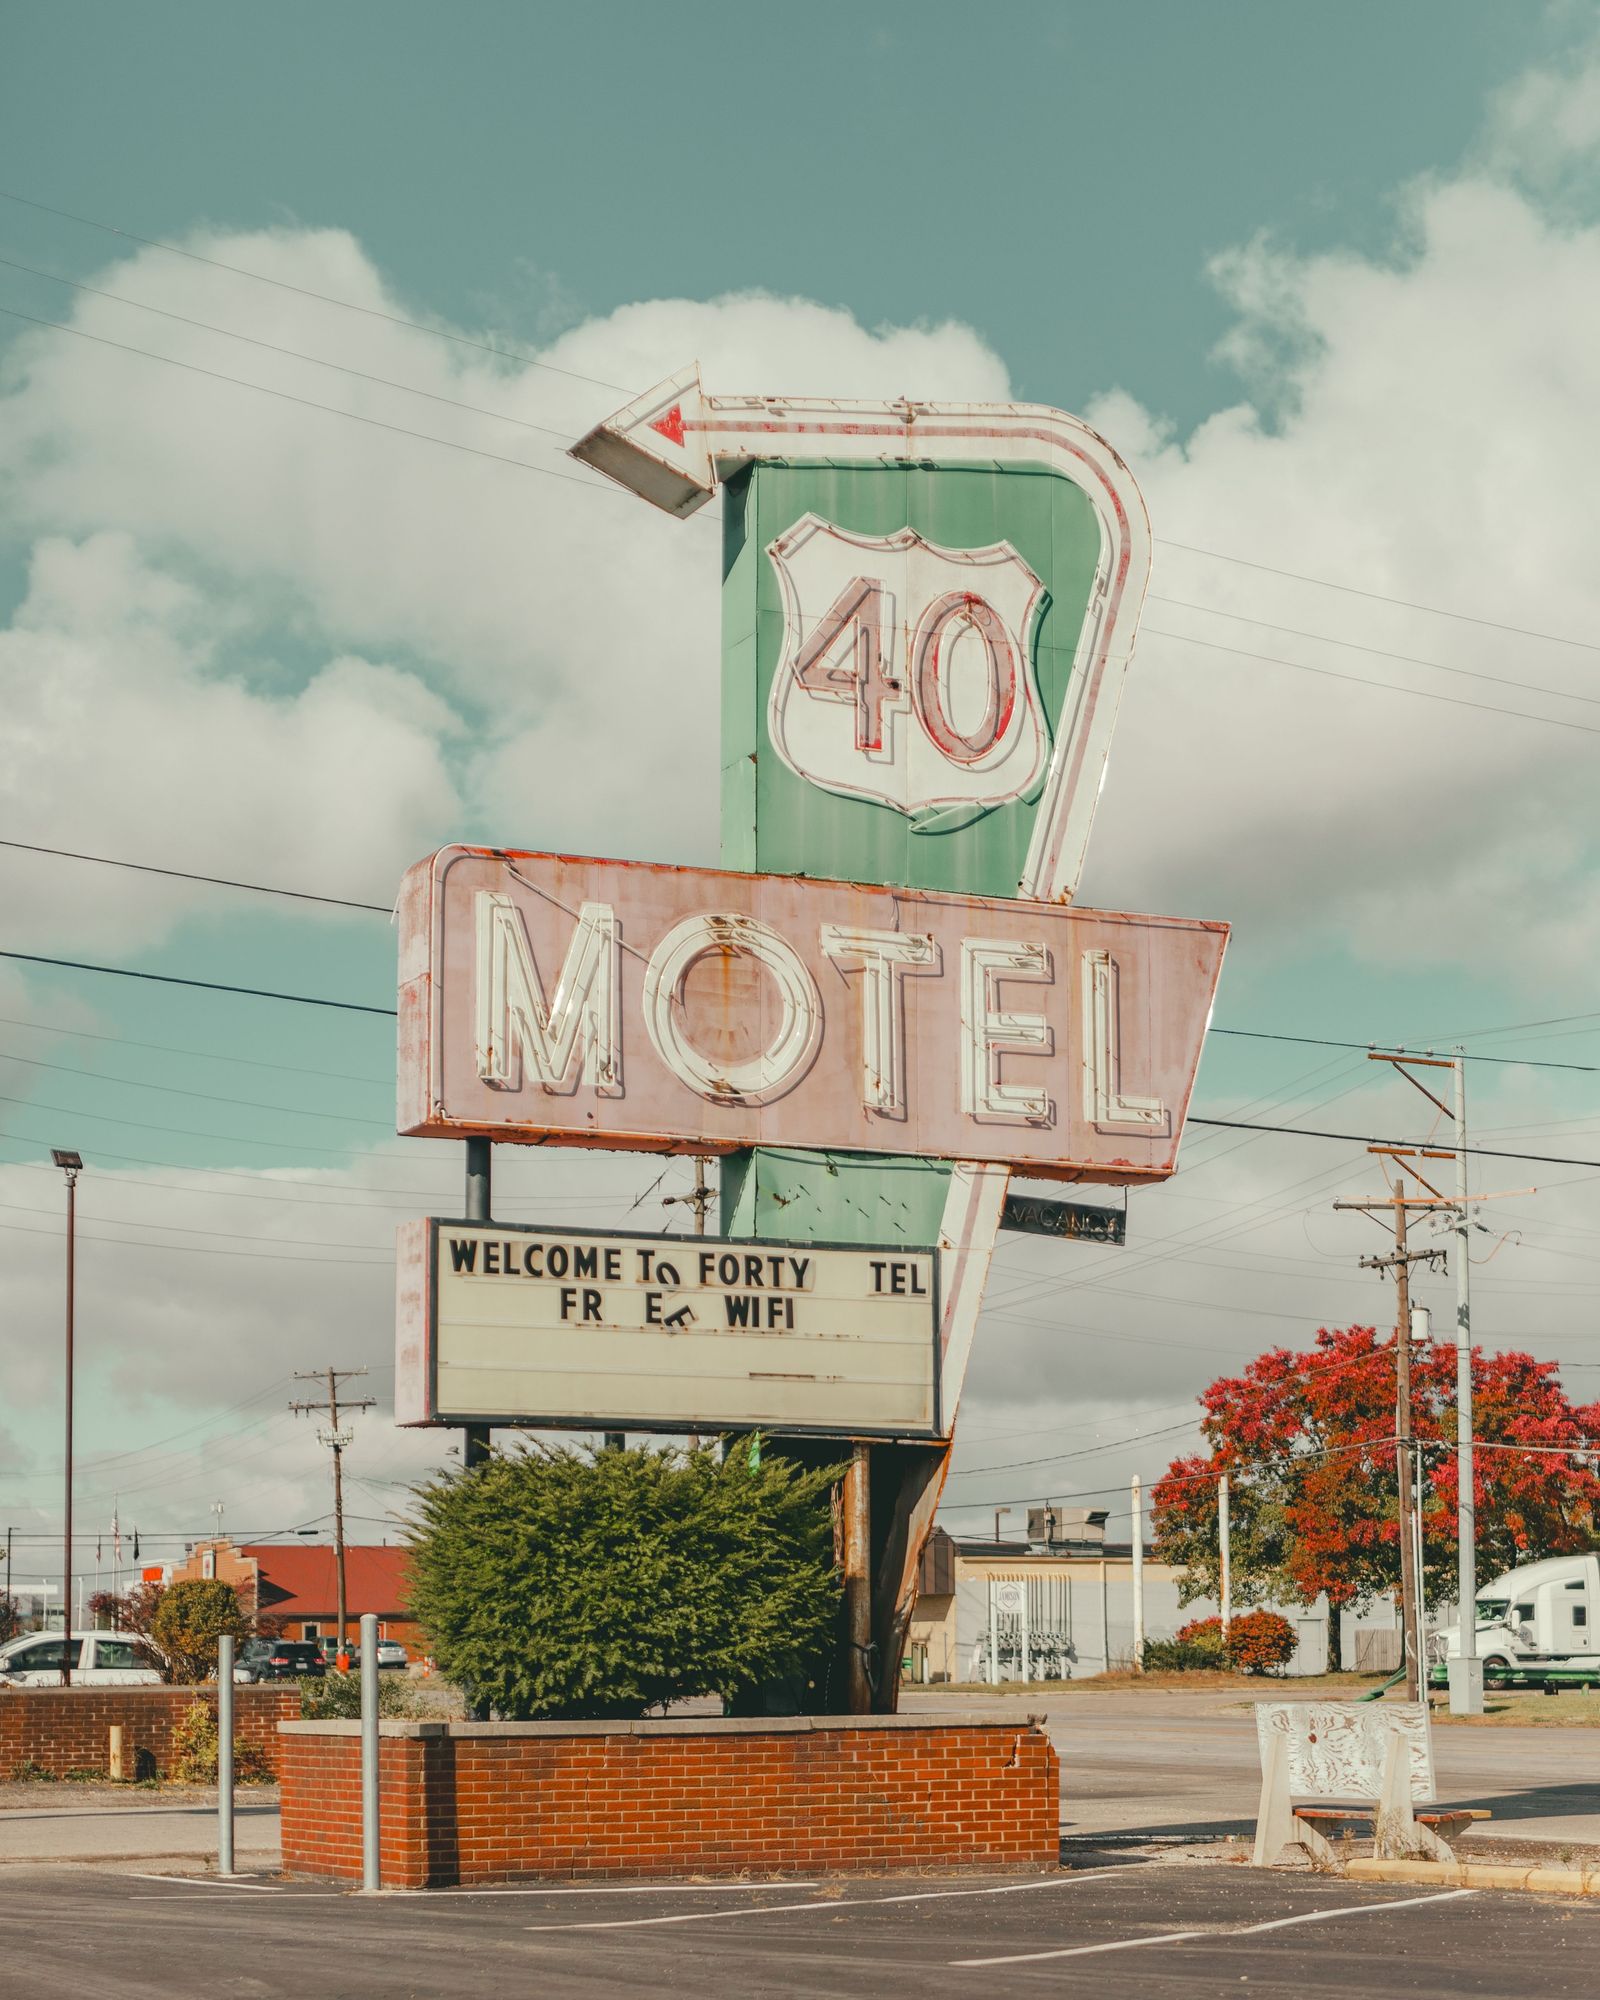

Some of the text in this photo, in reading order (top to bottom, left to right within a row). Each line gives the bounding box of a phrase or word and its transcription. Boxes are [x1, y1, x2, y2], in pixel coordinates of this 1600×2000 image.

[789, 575, 1019, 765] 40
[474, 889, 1165, 1127] MOTEL
[449, 1239, 927, 1295] WELCOME TO FORTY TEL
[723, 1294, 795, 1329] WIFI
